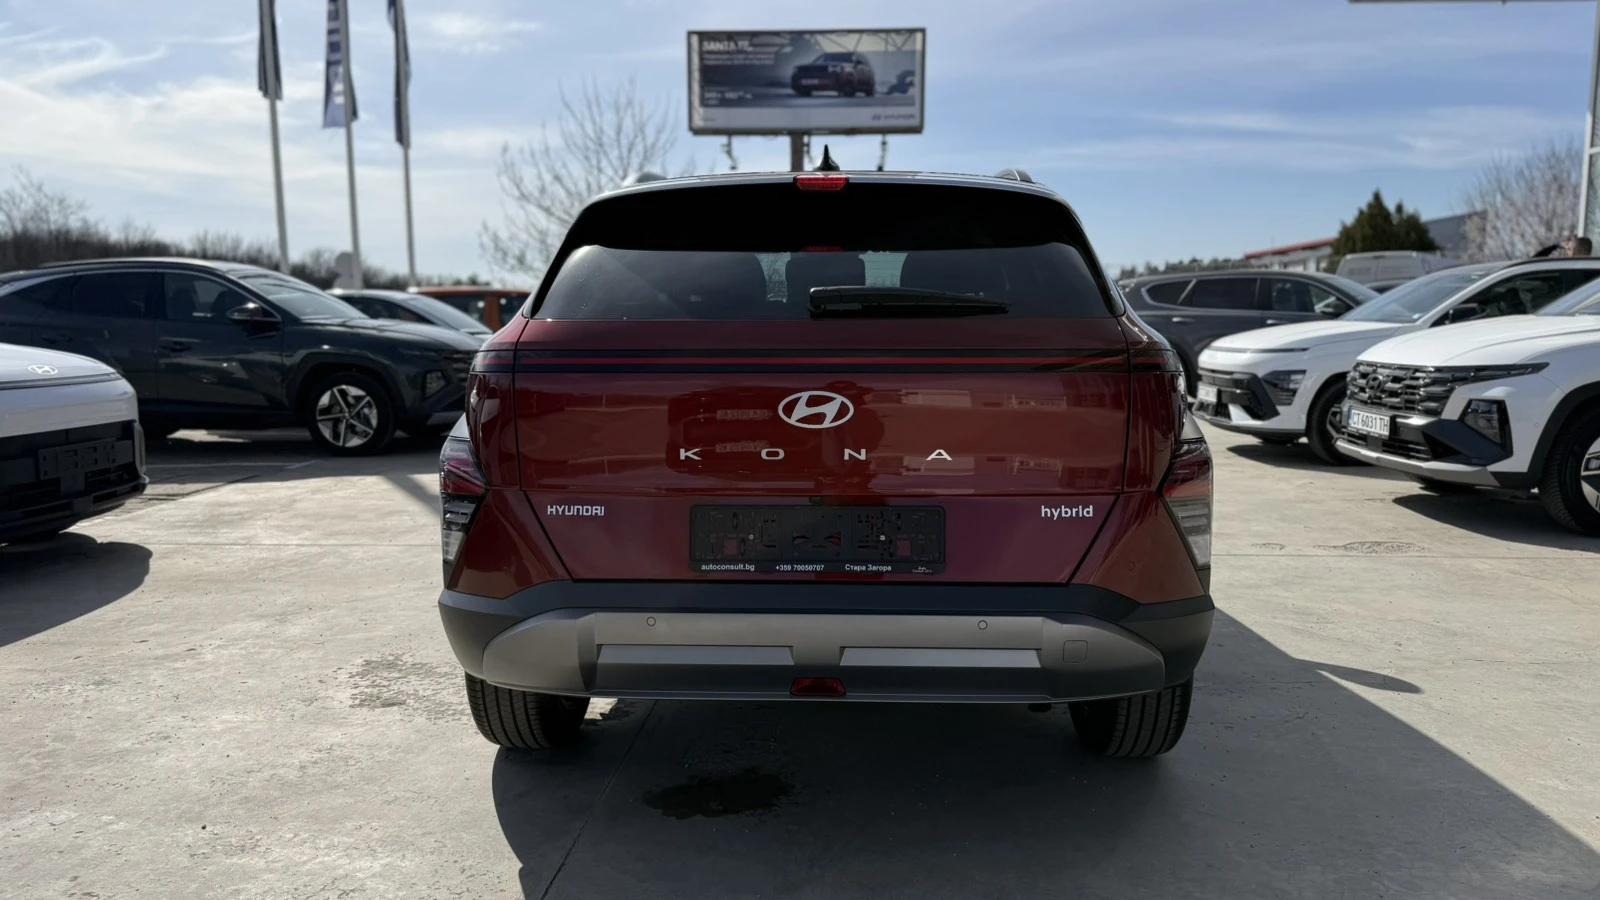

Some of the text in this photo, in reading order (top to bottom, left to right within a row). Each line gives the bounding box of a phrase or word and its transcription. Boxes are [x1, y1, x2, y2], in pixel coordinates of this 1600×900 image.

[1361, 414, 1378, 430] 6031
[680, 448, 953, 461] KONA
[547, 505, 605, 516] HYUNDAI
[1041, 505, 1094, 521] hybrid
[701, 563, 755, 572] autoconsult.bg
[845, 563, 892, 572] Стара Загора
